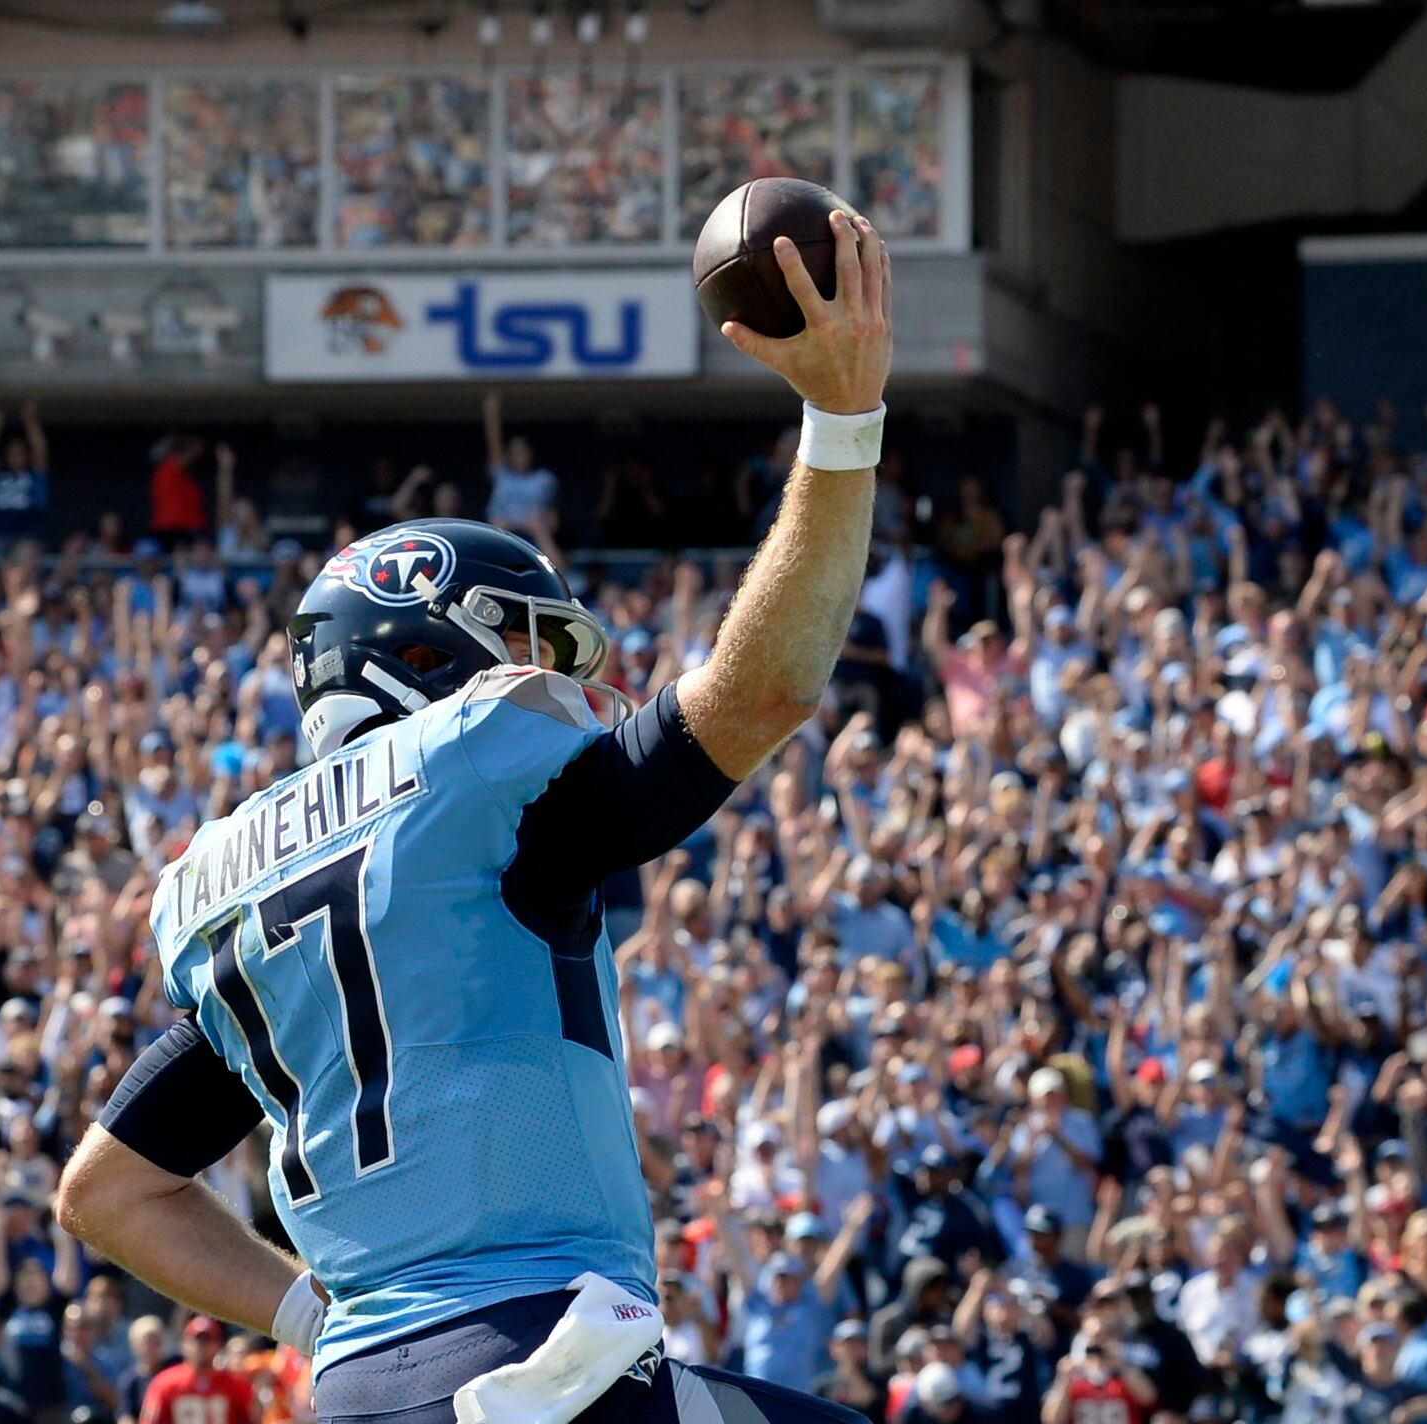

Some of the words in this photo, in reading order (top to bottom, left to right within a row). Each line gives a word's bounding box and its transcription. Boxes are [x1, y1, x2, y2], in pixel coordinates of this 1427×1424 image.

[425, 280, 654, 368] tsu
[173, 735, 420, 936] TANNEHILL
[199, 838, 396, 1211] 17
